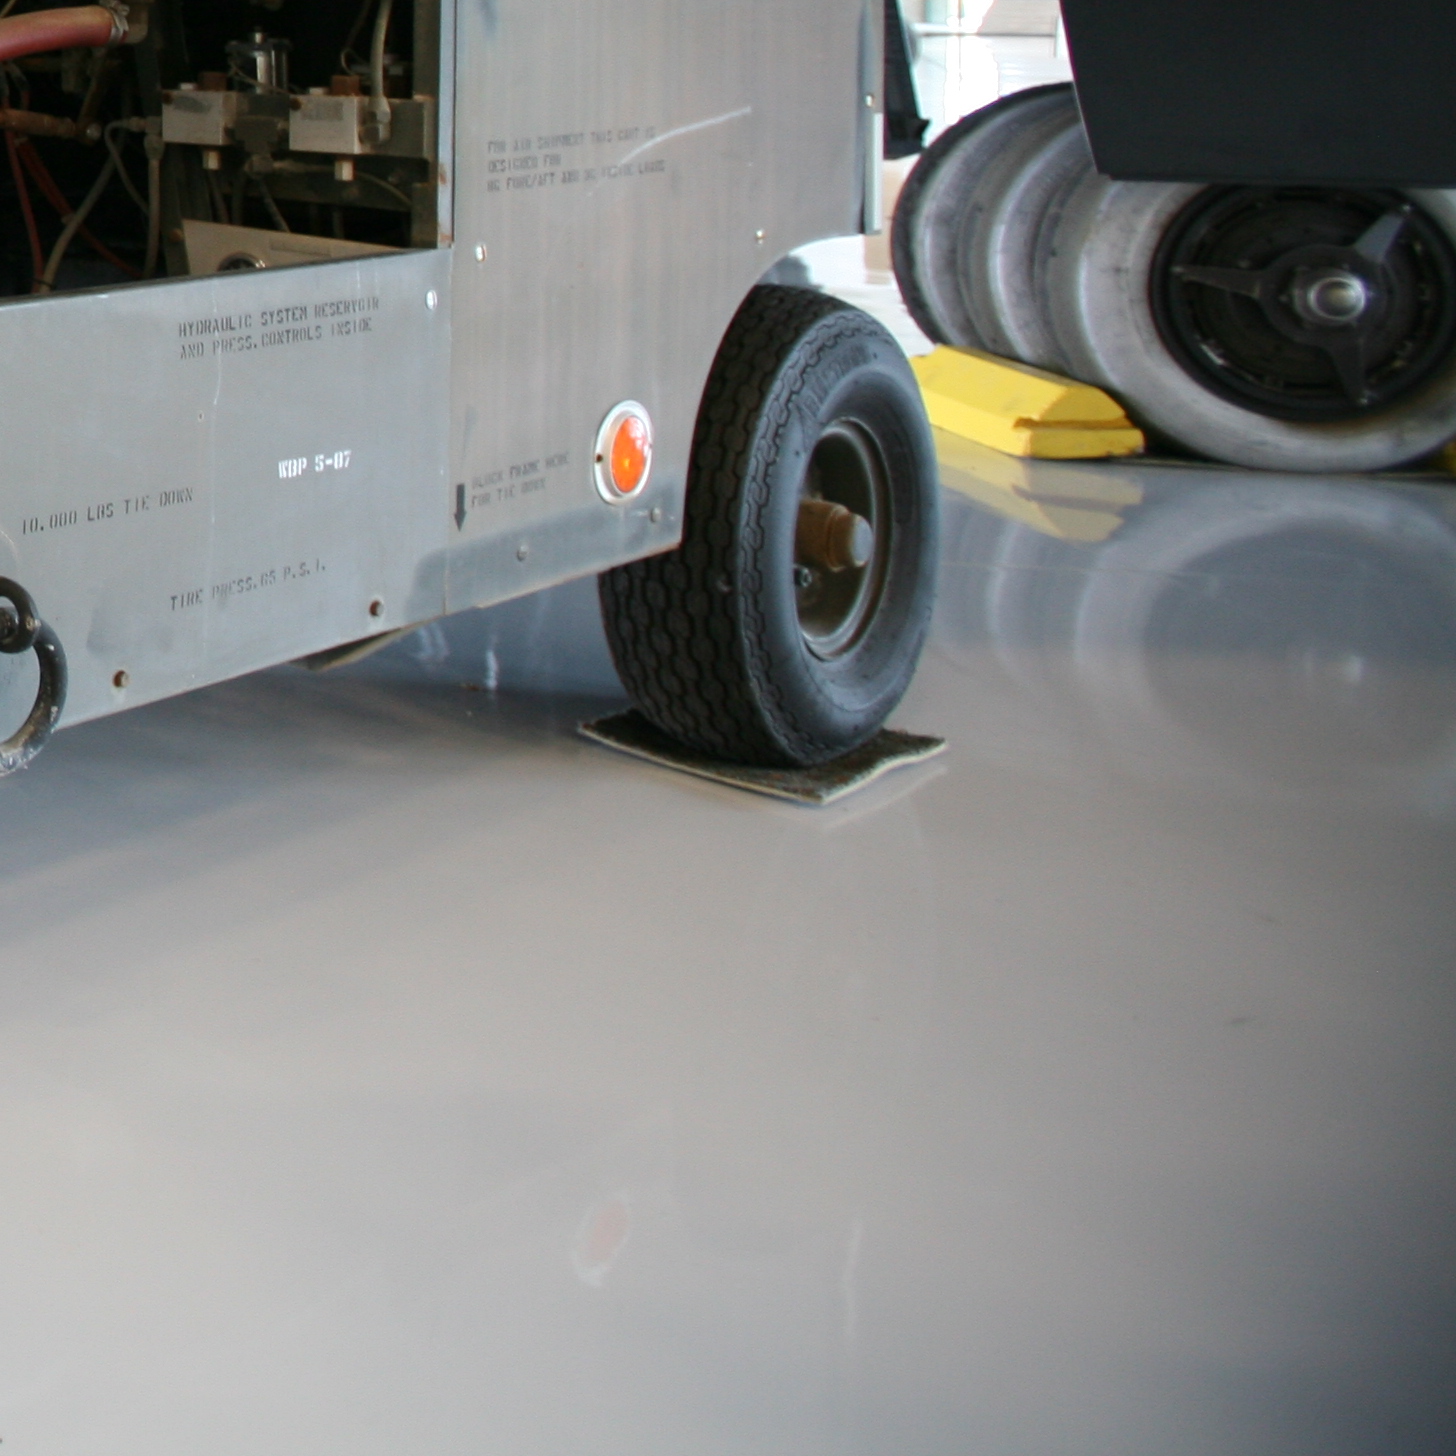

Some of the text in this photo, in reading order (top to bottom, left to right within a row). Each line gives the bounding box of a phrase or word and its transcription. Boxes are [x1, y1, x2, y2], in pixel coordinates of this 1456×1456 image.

[513, 137, 532, 152] AIR
[487, 155, 539, 174] DESIGNED
[178, 296, 380, 338] HYDRAULIC SYSTEM RESERVOIR
[180, 341, 204, 360] AND
[330, 316, 373, 337] INSIDE
[87, 502, 115, 522] LBS
[123, 495, 150, 515] TIE
[159, 487, 194, 508] DOWN
[170, 588, 204, 611] TIRE
